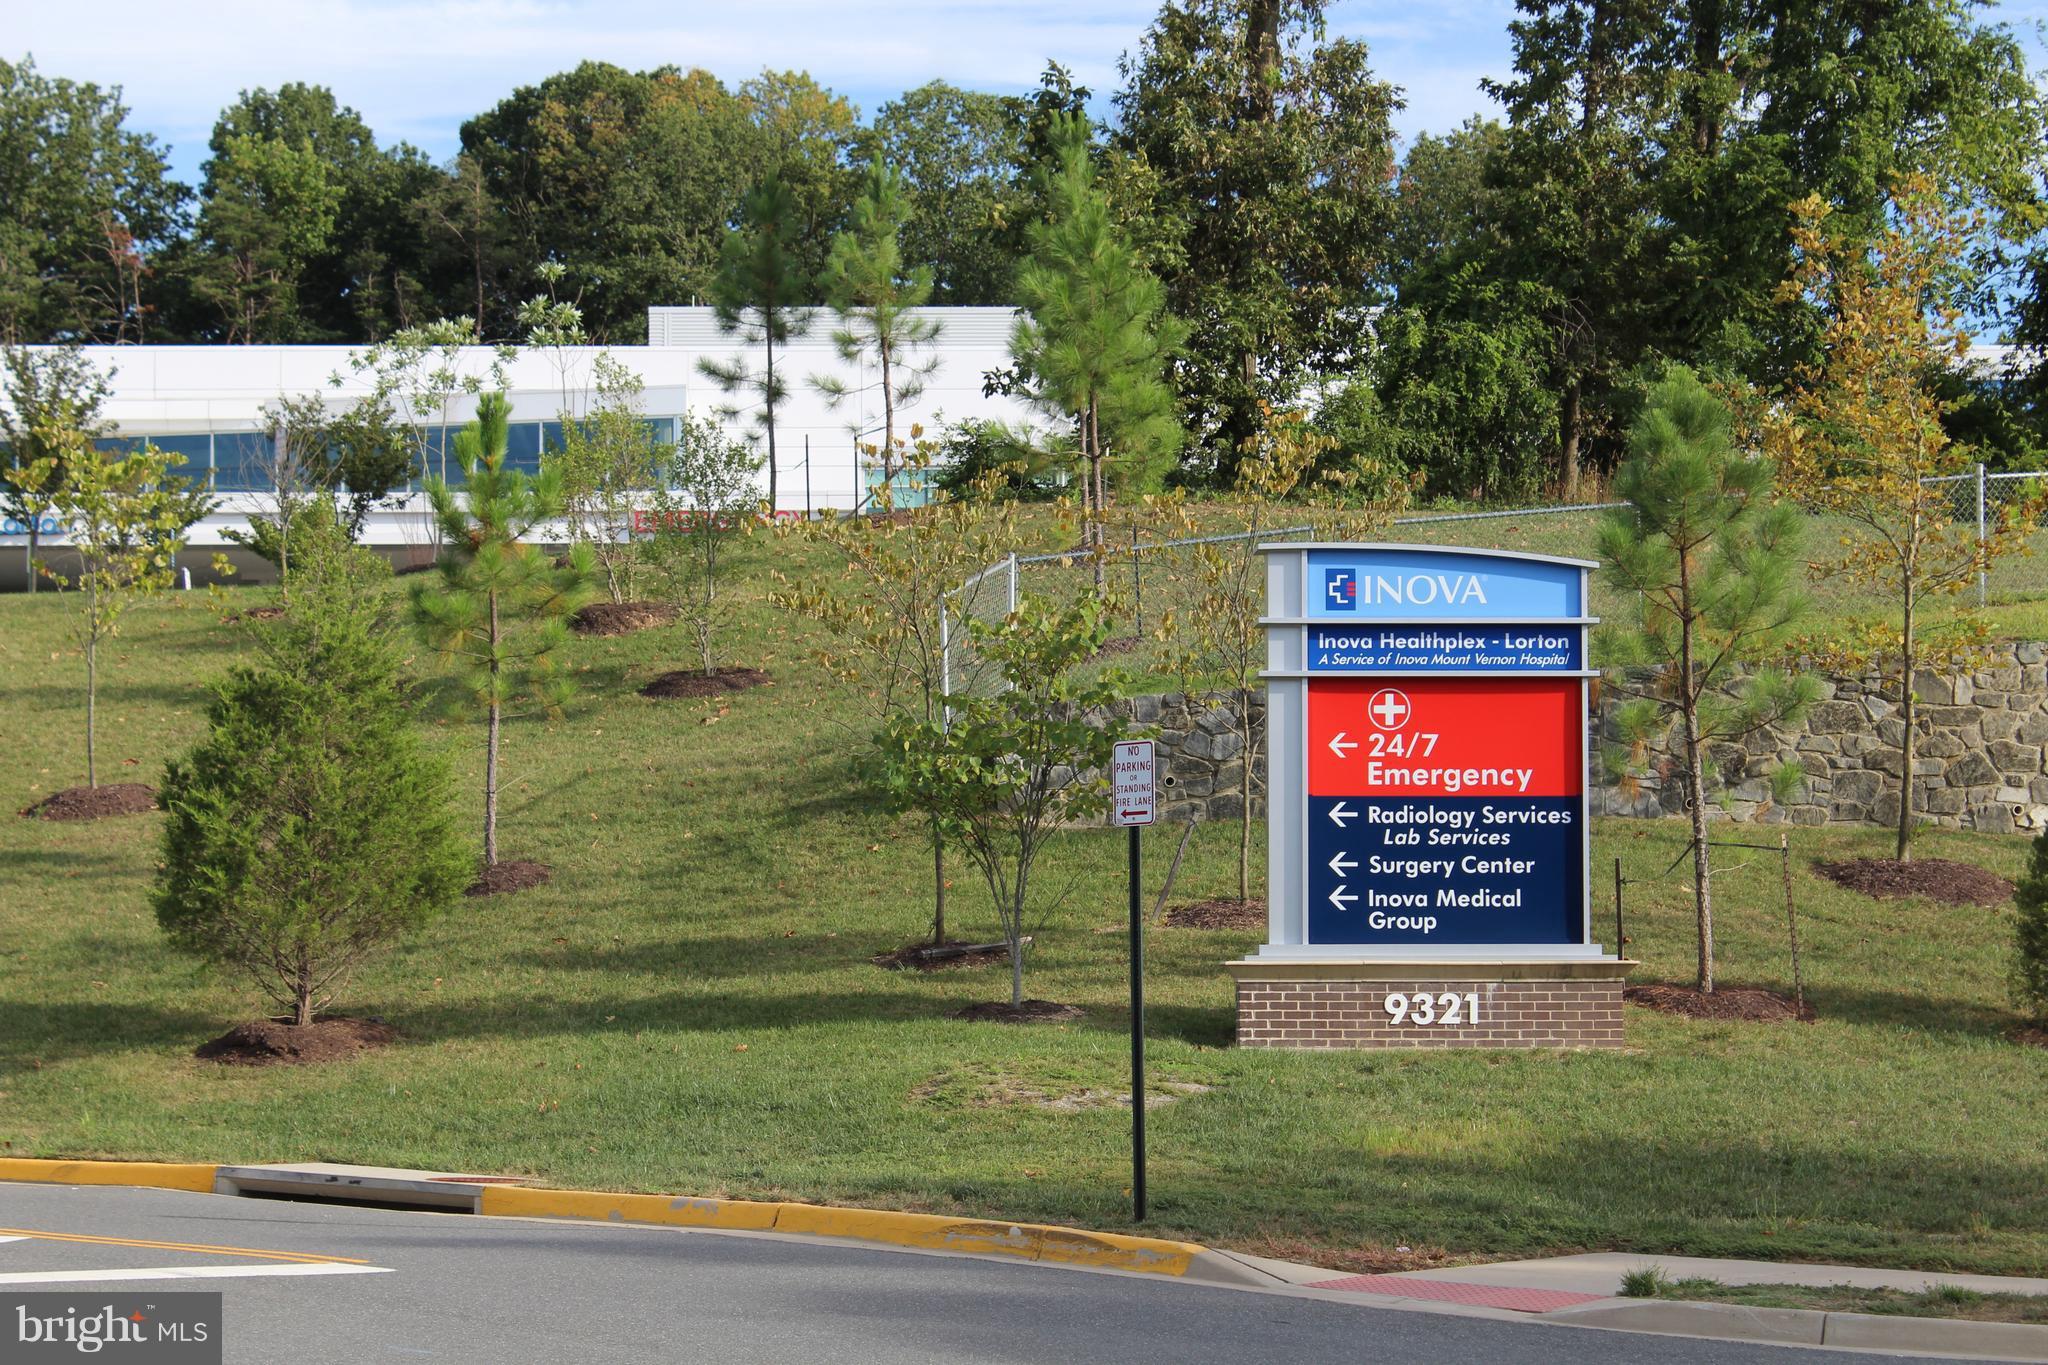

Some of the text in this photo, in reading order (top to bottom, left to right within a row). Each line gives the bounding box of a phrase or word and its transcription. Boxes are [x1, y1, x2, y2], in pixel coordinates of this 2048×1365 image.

[1365, 576, 1487, 604] INOVA
[1319, 633, 1372, 649] Inova
[1380, 632, 1486, 653] Healthplex
[1505, 633, 1568, 649] Lorton
[1318, 652, 1569, 667] A Service of Inova Mount Vernon Hospital
[1128, 746, 1139, 756] NO
[1369, 732, 1438, 758] 24/7
[1116, 761, 1151, 773] PARKING
[1368, 762, 1532, 792] Emergency
[1116, 783, 1151, 794] STANDING
[1116, 796, 1151, 807] FIRE LANE
[1368, 805, 1571, 828] Radiology Services
[1384, 828, 1511, 845] Lab Services
[1370, 856, 1535, 878] Surgery Center
[1369, 889, 1521, 907] Inova Medical
[1369, 911, 1436, 933] Group
[1383, 992, 1480, 1026] 9321
